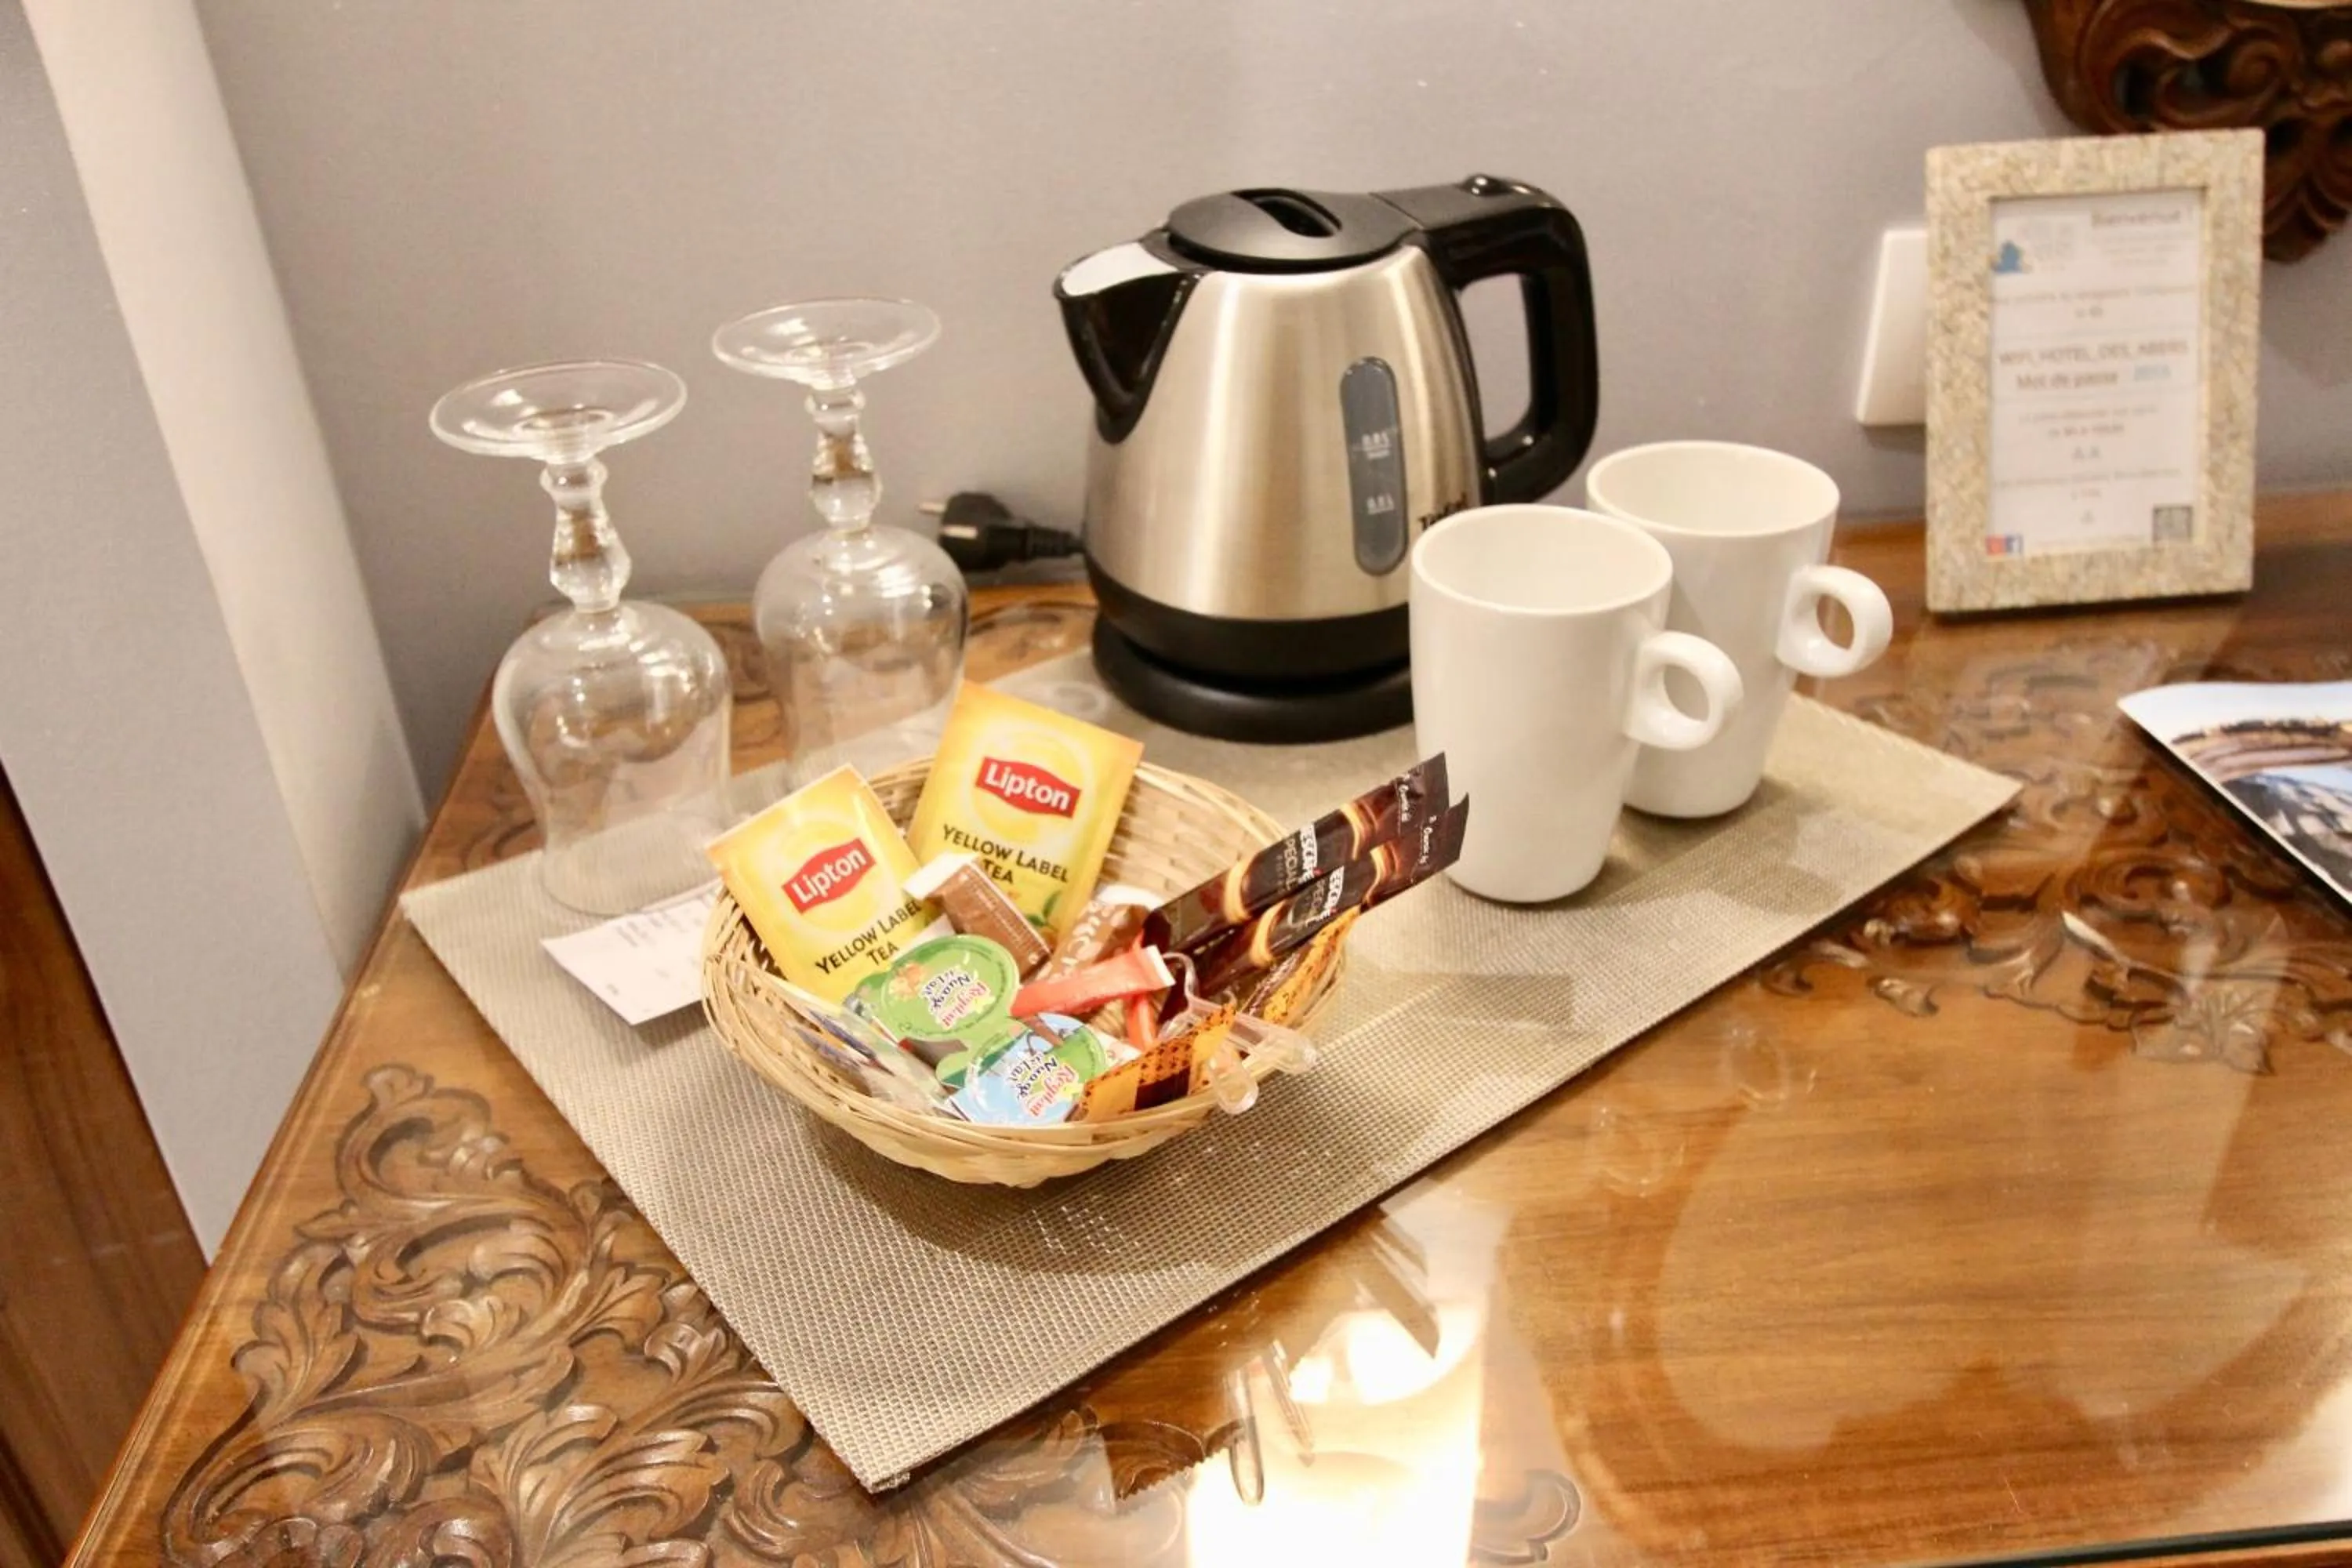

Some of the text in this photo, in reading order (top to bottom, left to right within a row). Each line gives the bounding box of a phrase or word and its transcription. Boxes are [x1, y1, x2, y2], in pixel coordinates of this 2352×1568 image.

[984, 762, 1071, 811] Lipton
[790, 848, 868, 904] Lipton
[942, 823, 1069, 884] YELLOW LABEL
[982, 858, 1014, 885] TEA
[815, 927, 879, 975] YELLOW
[877, 899, 923, 935] LABEL
[866, 939, 900, 966] TEA
